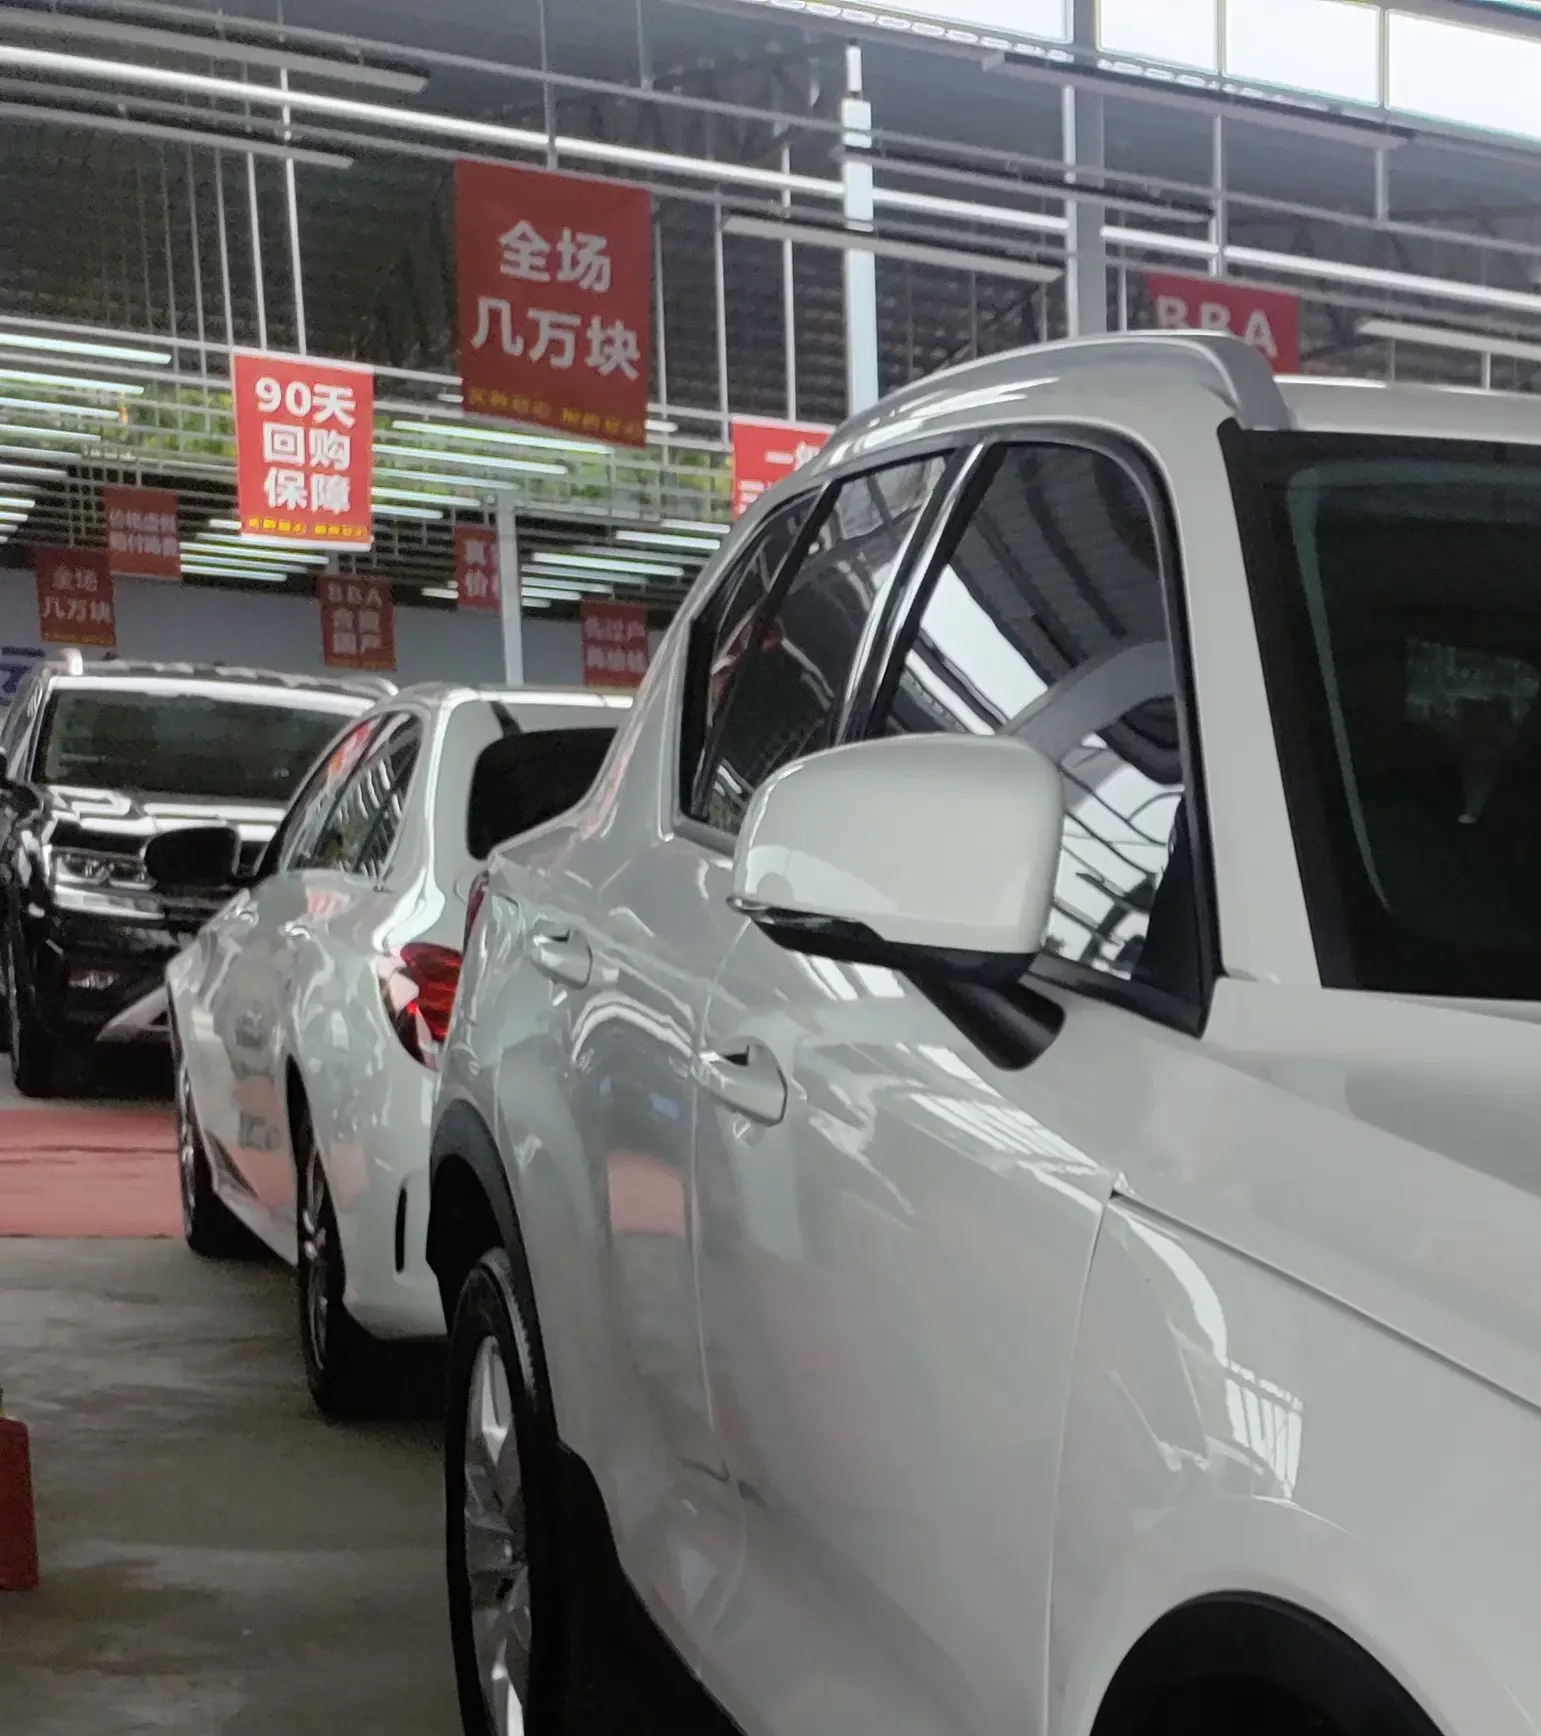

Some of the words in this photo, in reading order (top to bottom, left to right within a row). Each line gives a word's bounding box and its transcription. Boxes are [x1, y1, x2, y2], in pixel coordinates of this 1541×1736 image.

[497, 220, 612, 294] 全场
[471, 296, 641, 381] 几万块
[255, 376, 356, 428] 90天
[263, 421, 350, 471] 回购
[264, 467, 351, 515] 保障
